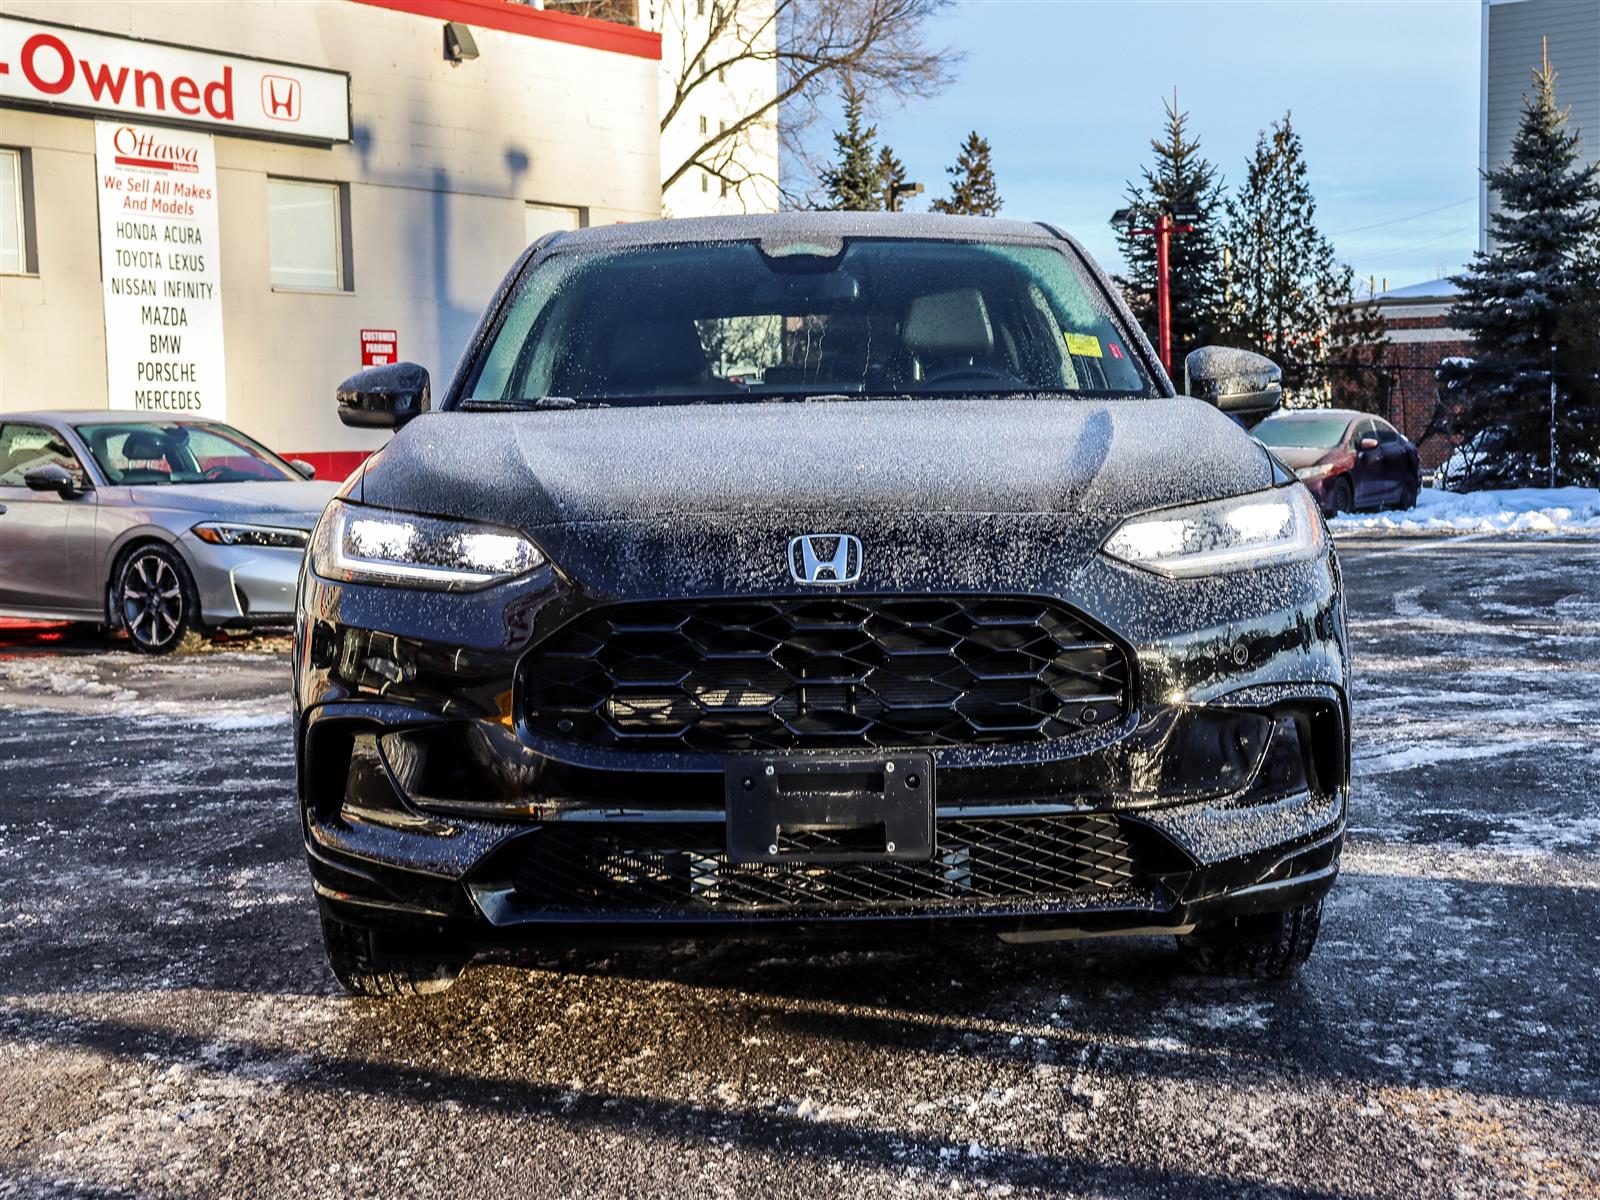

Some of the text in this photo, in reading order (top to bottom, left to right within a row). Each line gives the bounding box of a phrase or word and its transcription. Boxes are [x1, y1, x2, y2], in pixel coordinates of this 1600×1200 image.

[113, 126, 199, 162] Ottawa
[104, 175, 212, 200] We Sell All Makes
[123, 195, 194, 216] And Models
[116, 221, 203, 244] HONDA ACURA
[115, 249, 206, 272] TOYOTA LEXUS
[111, 277, 214, 299] NISSAN INFINITY
[141, 305, 188, 327] MAZDA
[150, 334, 182, 354] BMW
[362, 331, 396, 342] CUSTOMER
[365, 342, 394, 354] PARKING
[137, 361, 197, 382] PORSCHE
[134, 389, 202, 411] MERCEDES
